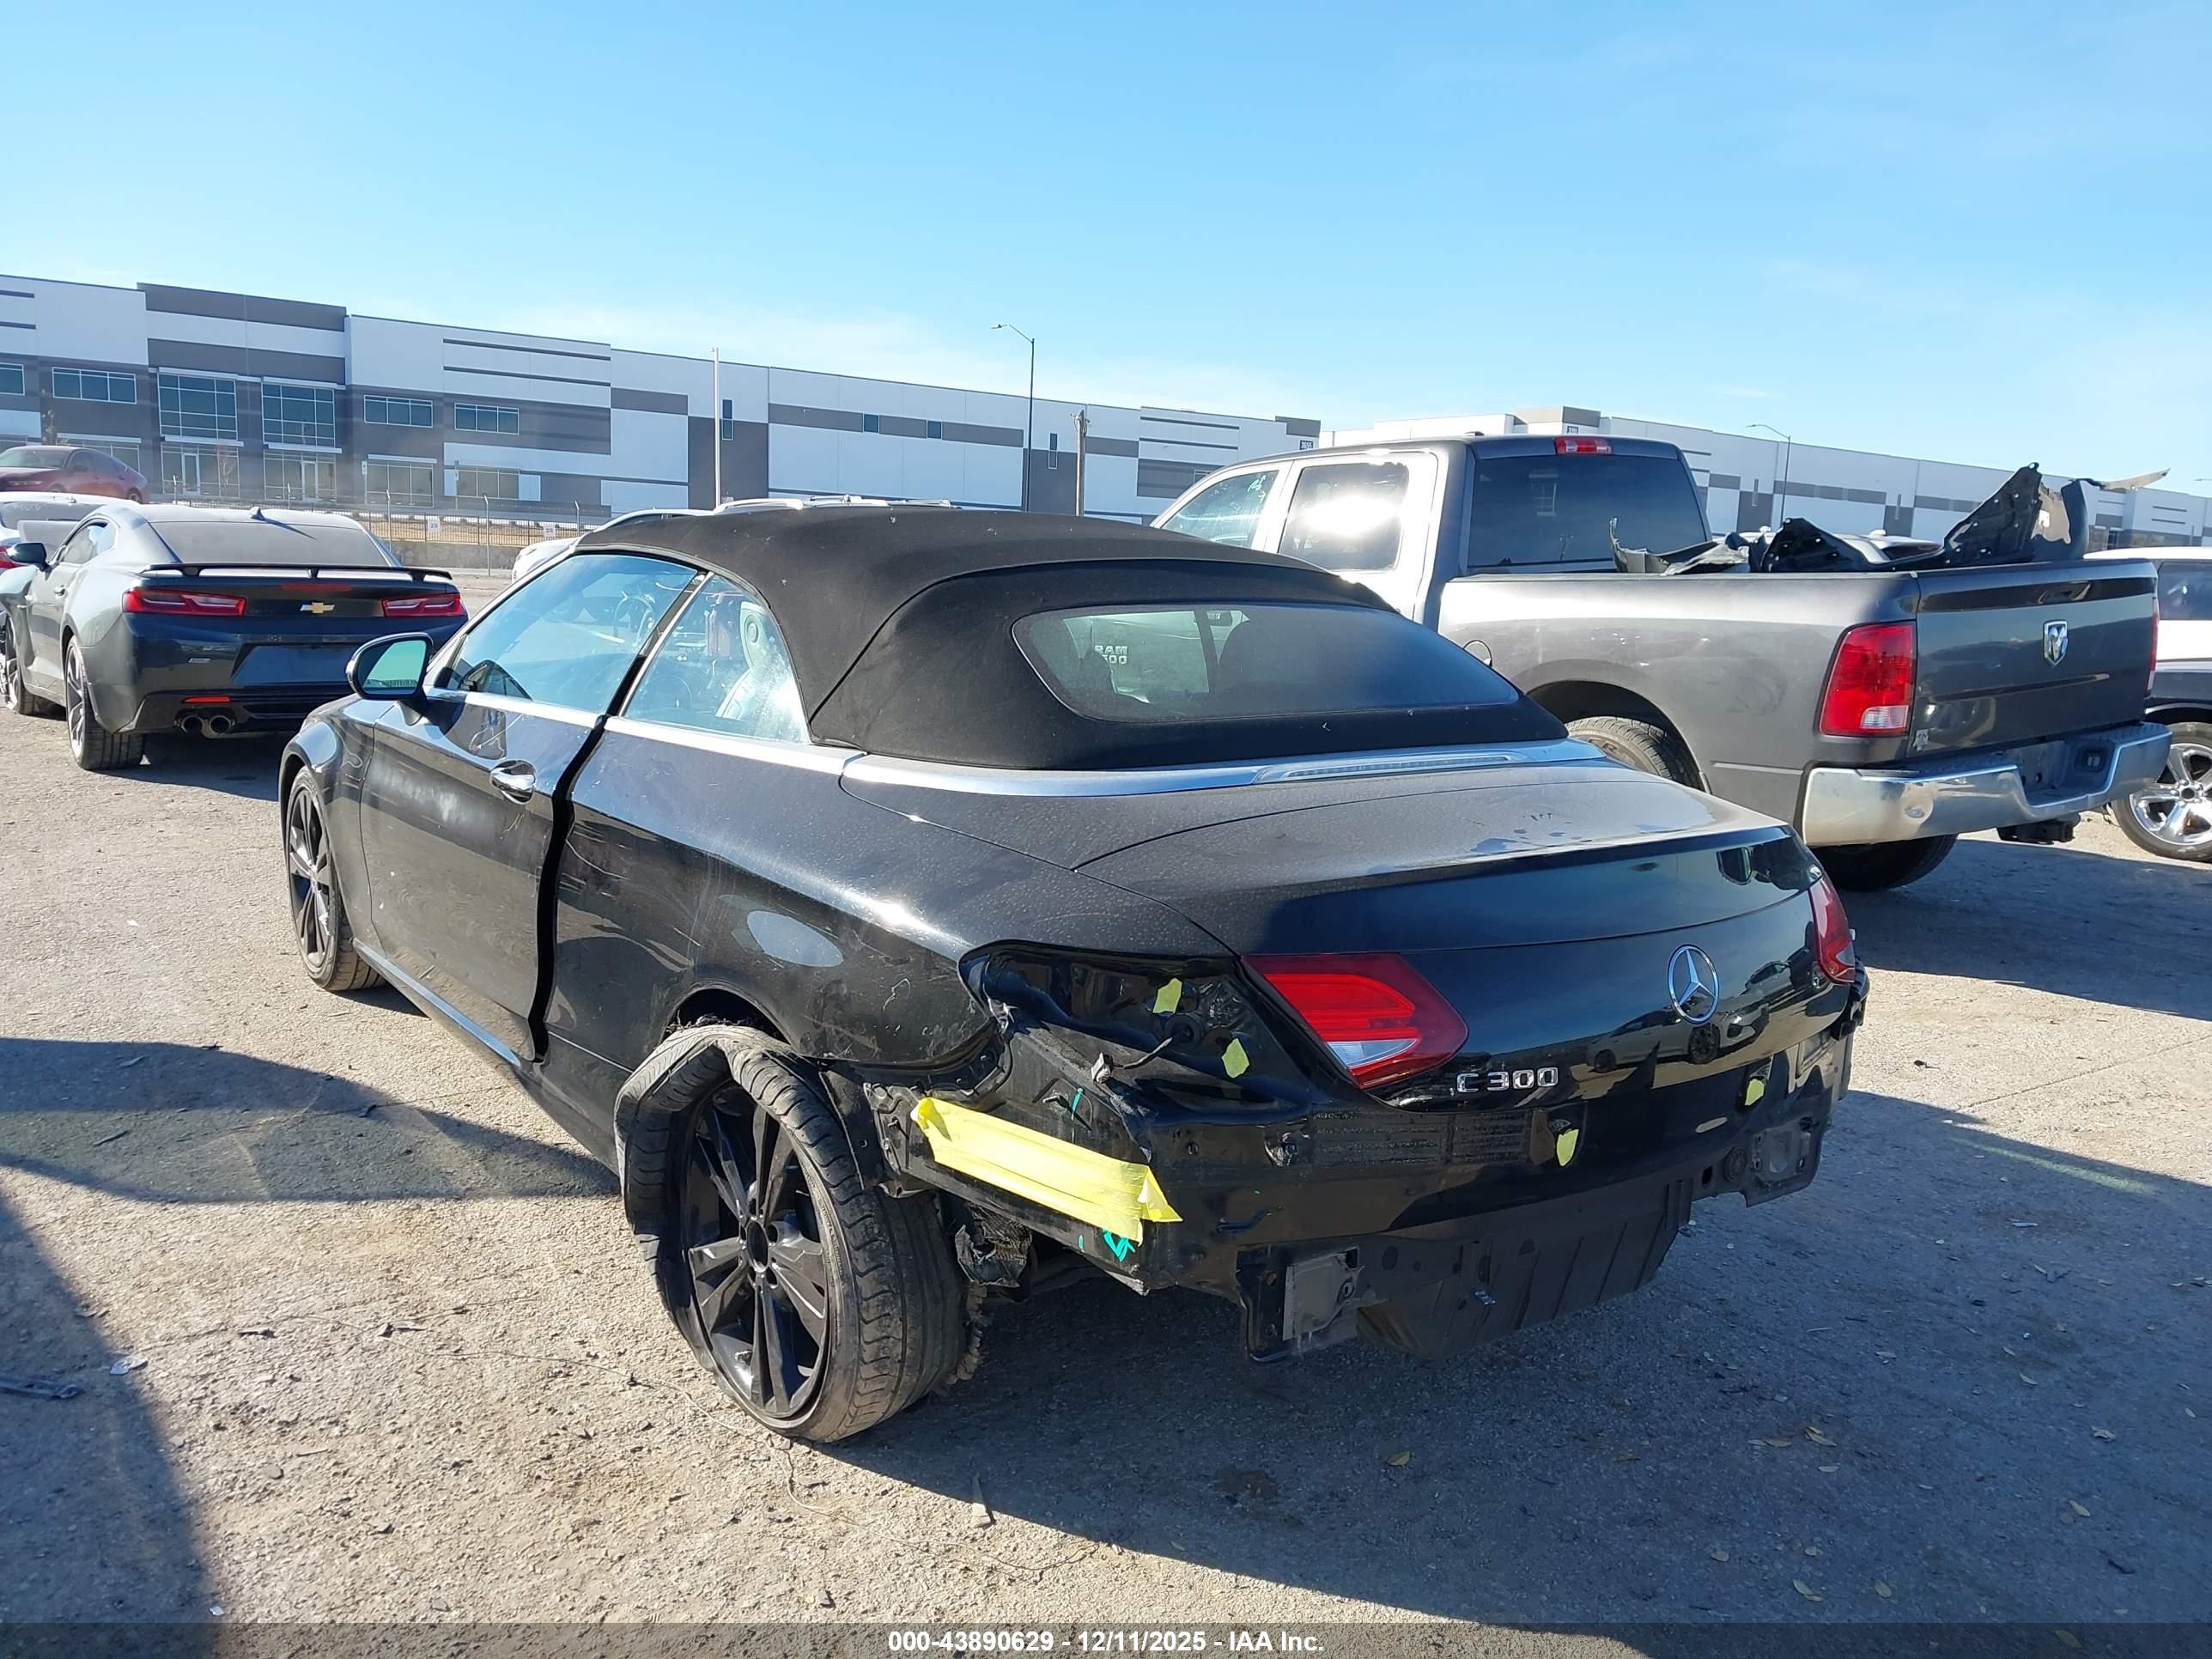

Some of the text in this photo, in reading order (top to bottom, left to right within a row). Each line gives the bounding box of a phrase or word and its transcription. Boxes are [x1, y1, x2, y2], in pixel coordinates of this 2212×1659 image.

[1094, 645, 1128, 655] RAM
[1457, 1066, 1559, 1093] C 300
